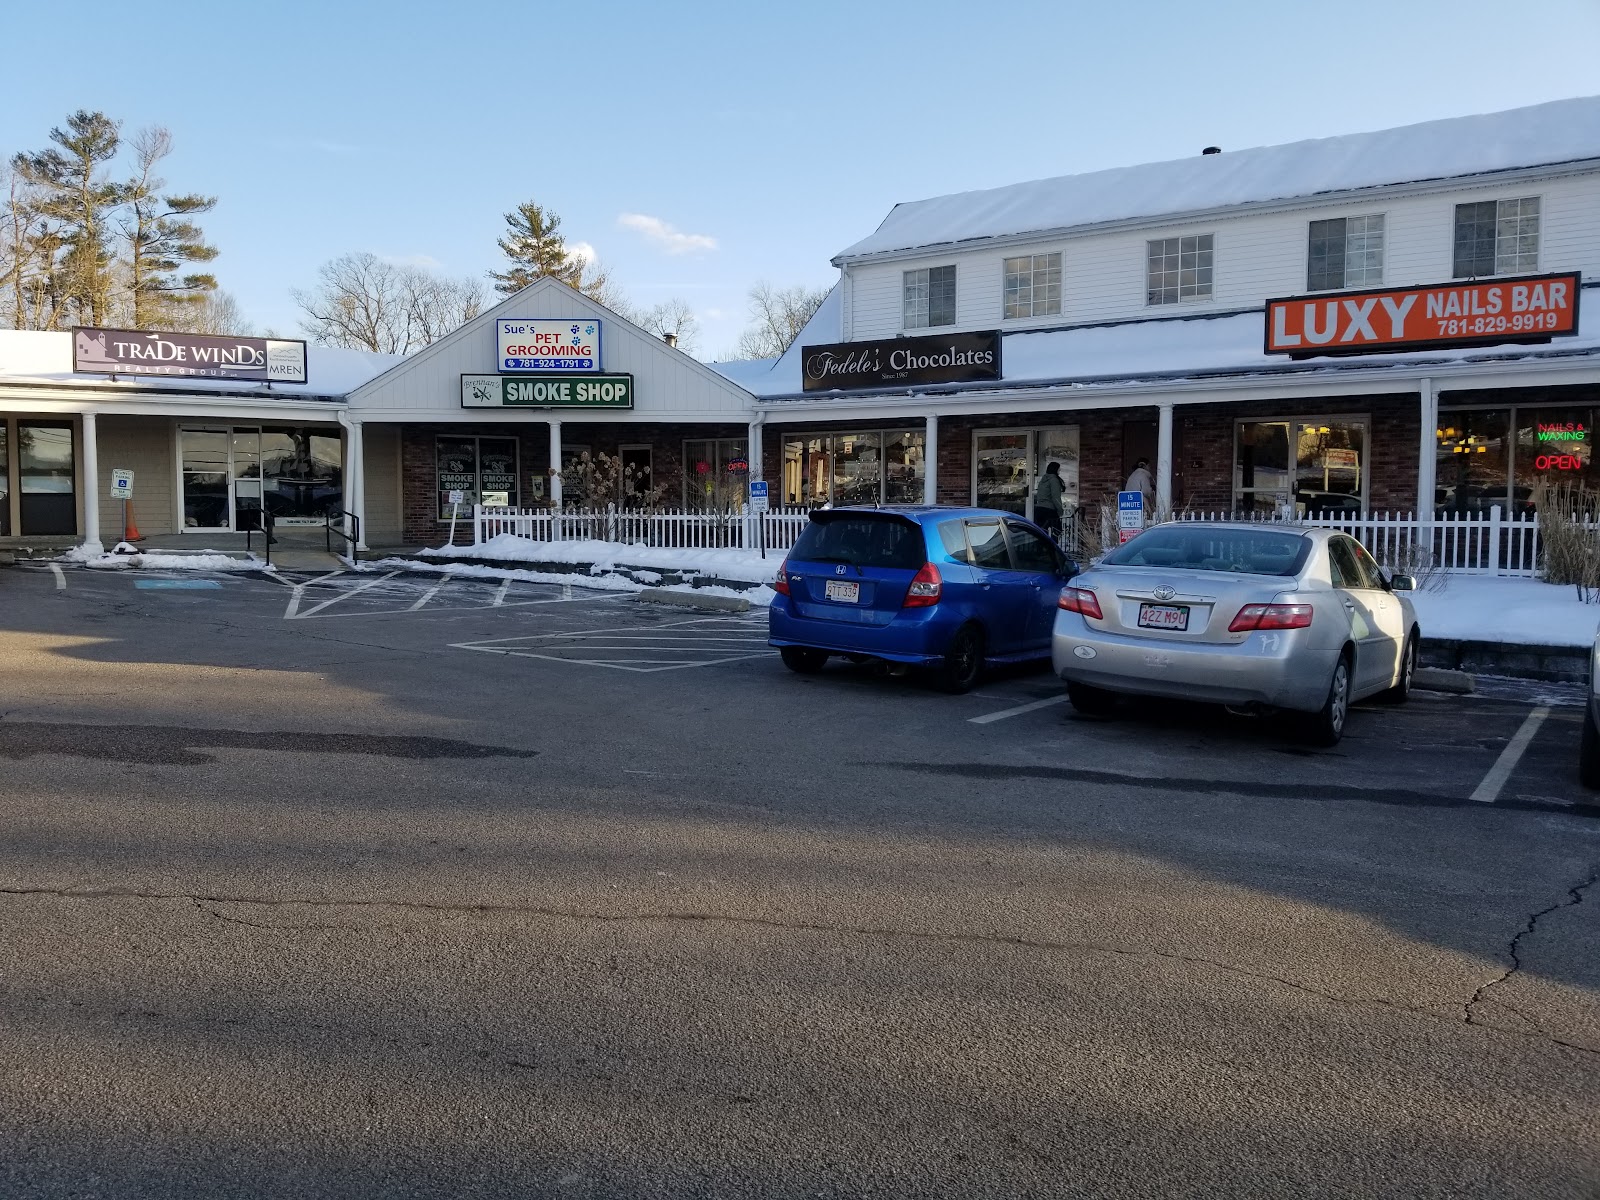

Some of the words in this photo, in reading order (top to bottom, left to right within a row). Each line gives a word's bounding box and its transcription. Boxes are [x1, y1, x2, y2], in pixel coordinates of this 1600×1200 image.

[1273, 295, 1418, 346] LUXY
[1427, 287, 1503, 319] NAILS
[1511, 283, 1567, 312] BAR
[504, 324, 535, 334] Sue's
[1437, 312, 1557, 336] 781-829-9919
[535, 333, 562, 344] PET
[506, 345, 592, 356] GROOMING
[519, 359, 579, 368] 781-924-1791
[806, 348, 884, 380] Fedele's
[890, 346, 993, 370] Chocolates
[114, 364, 171, 373] REALTY
[179, 368, 227, 376] GROUP
[269, 365, 302, 375] MREN
[881, 372, 896, 380] Since
[463, 379, 500, 390] Brennan's
[506, 382, 571, 402] SMOKE
[576, 382, 627, 402] SHOP
[1538, 423, 1574, 432] NAILS
[1538, 431, 1585, 441] WAXING
[727, 462, 748, 471] OPEN
[1535, 455, 1582, 469] OPEN
[441, 474, 473, 482] SMOKE
[483, 475, 514, 483] SMOKE
[445, 482, 470, 490] SHOP
[487, 482, 511, 490] SHOP
[842, 586, 857, 598] 339
